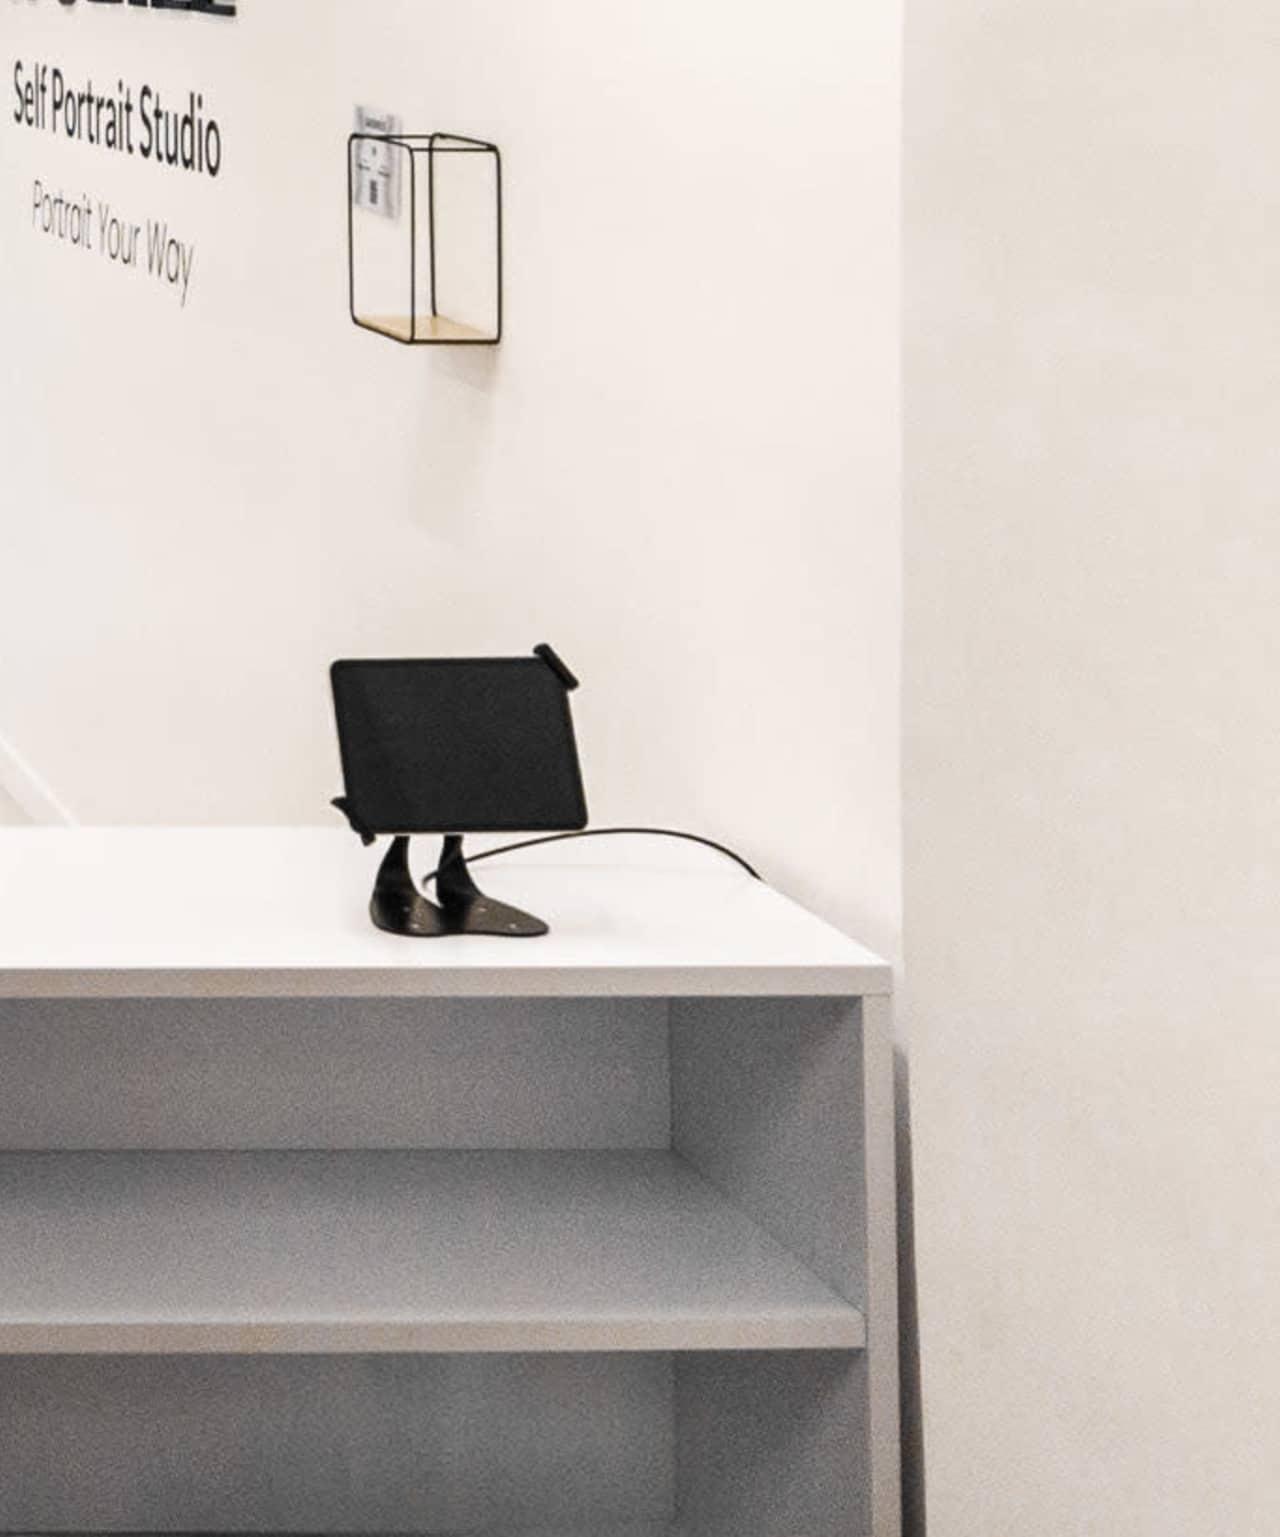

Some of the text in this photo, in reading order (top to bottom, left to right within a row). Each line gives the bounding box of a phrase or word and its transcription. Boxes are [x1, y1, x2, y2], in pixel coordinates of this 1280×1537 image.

[13, 60, 221, 177] Self Portrait Studio
[32, 179, 194, 307] Portrait Your Way
